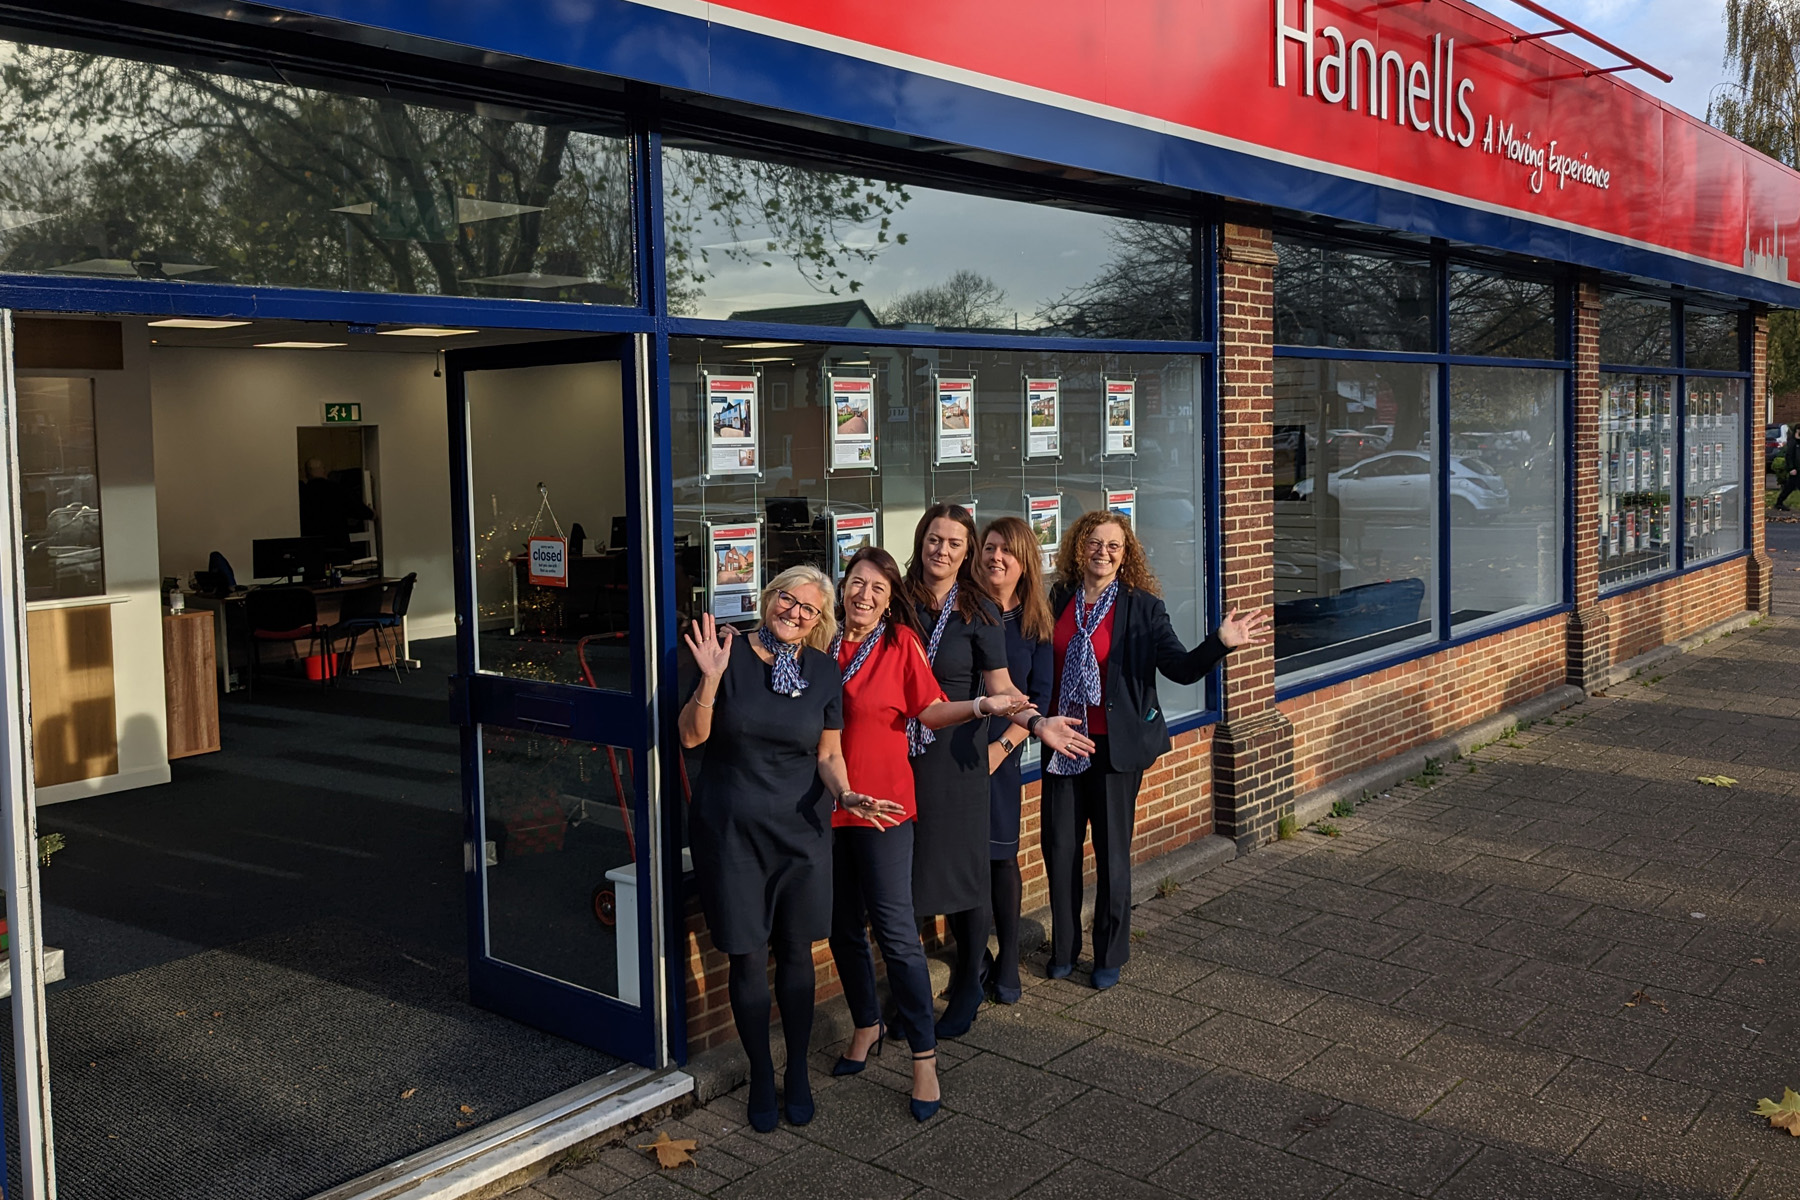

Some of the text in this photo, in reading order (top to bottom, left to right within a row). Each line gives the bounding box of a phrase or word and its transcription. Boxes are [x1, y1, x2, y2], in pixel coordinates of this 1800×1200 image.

[1276, 0, 1475, 148] Hannells
[1483, 114, 1610, 194] A Moving Experience
[533, 548, 562, 562] closed
